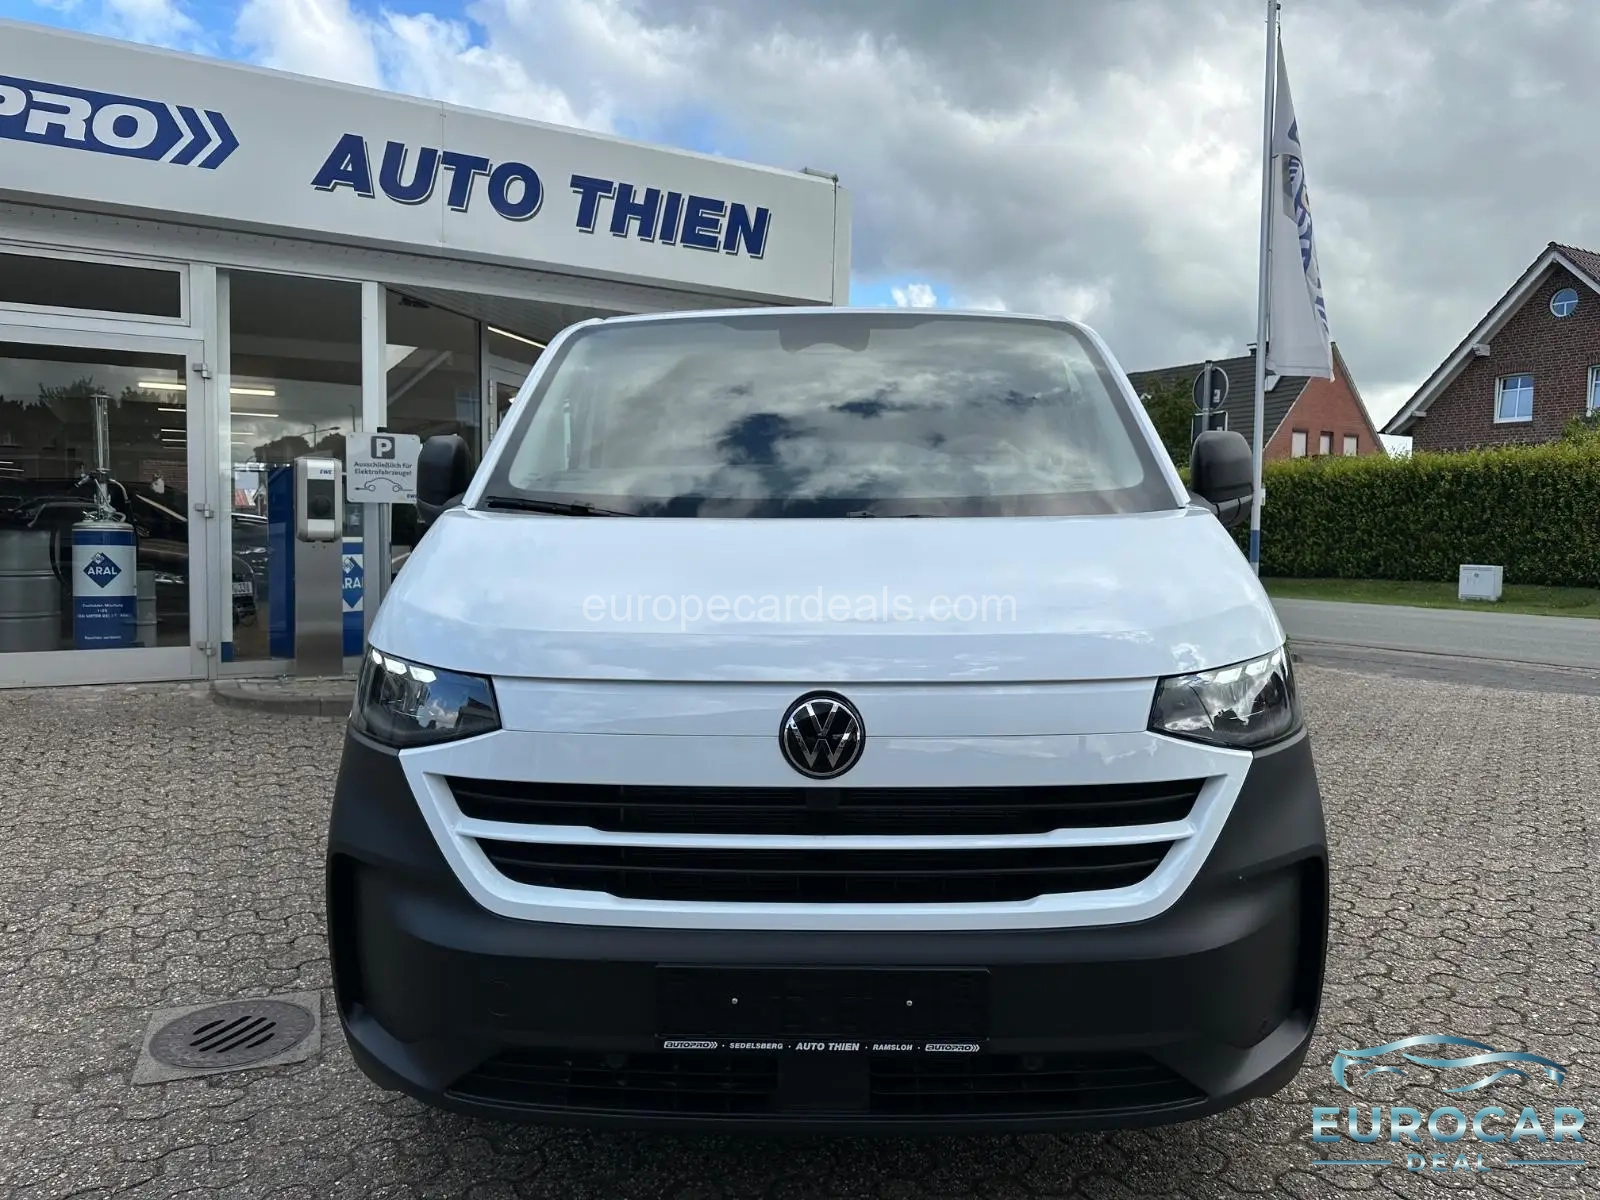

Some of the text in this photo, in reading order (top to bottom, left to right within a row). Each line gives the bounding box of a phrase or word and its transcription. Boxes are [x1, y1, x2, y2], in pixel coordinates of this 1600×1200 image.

[311, 133, 772, 260] AUTO THIEN
[376, 437, 393, 458] P
[87, 566, 118, 576] ARAL
[341, 576, 364, 589] RA
[729, 1042, 784, 1050] SEDELSBERG
[795, 1042, 825, 1051] AUTO
[827, 1042, 860, 1051] THIEN
[872, 1043, 913, 1051] RAMSLOH
